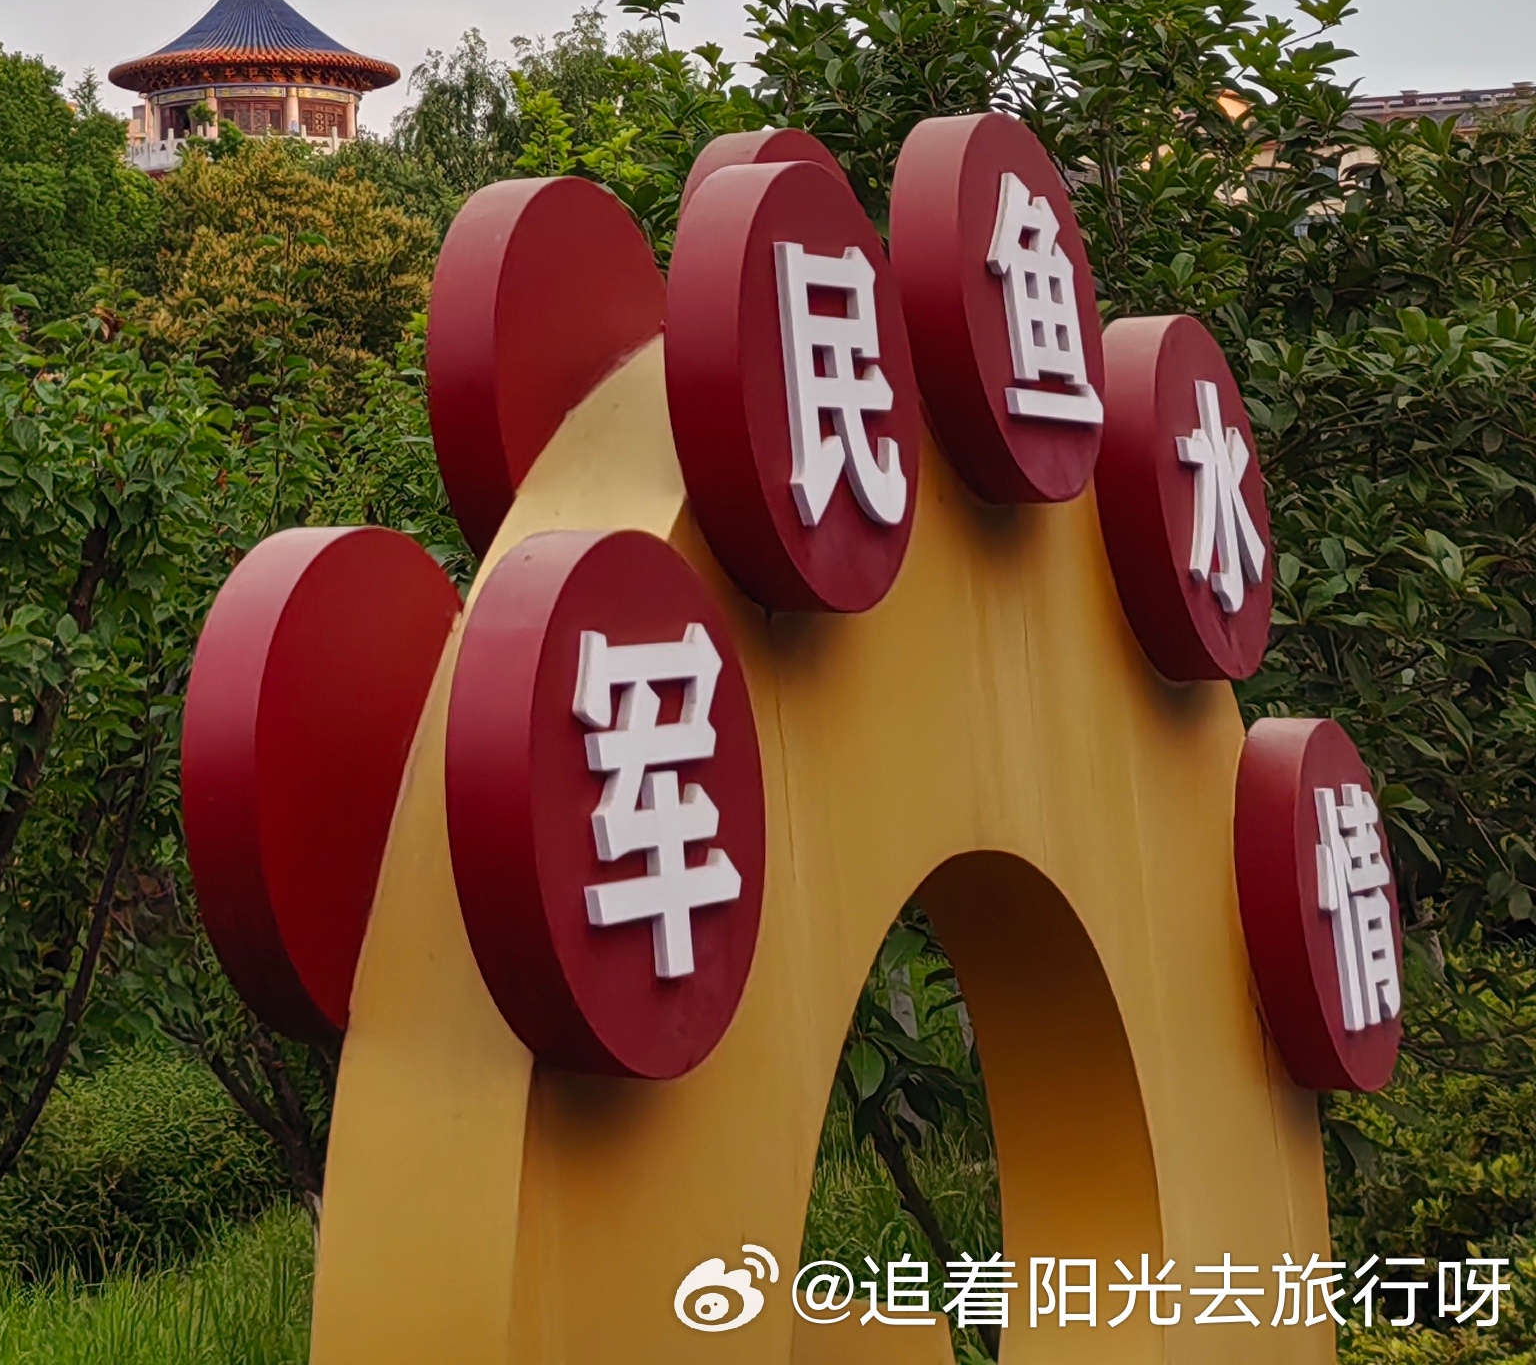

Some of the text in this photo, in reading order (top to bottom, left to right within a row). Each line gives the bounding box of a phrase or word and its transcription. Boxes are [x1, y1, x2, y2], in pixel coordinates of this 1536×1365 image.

[572, 171, 1402, 1032] 军民鱼水情
